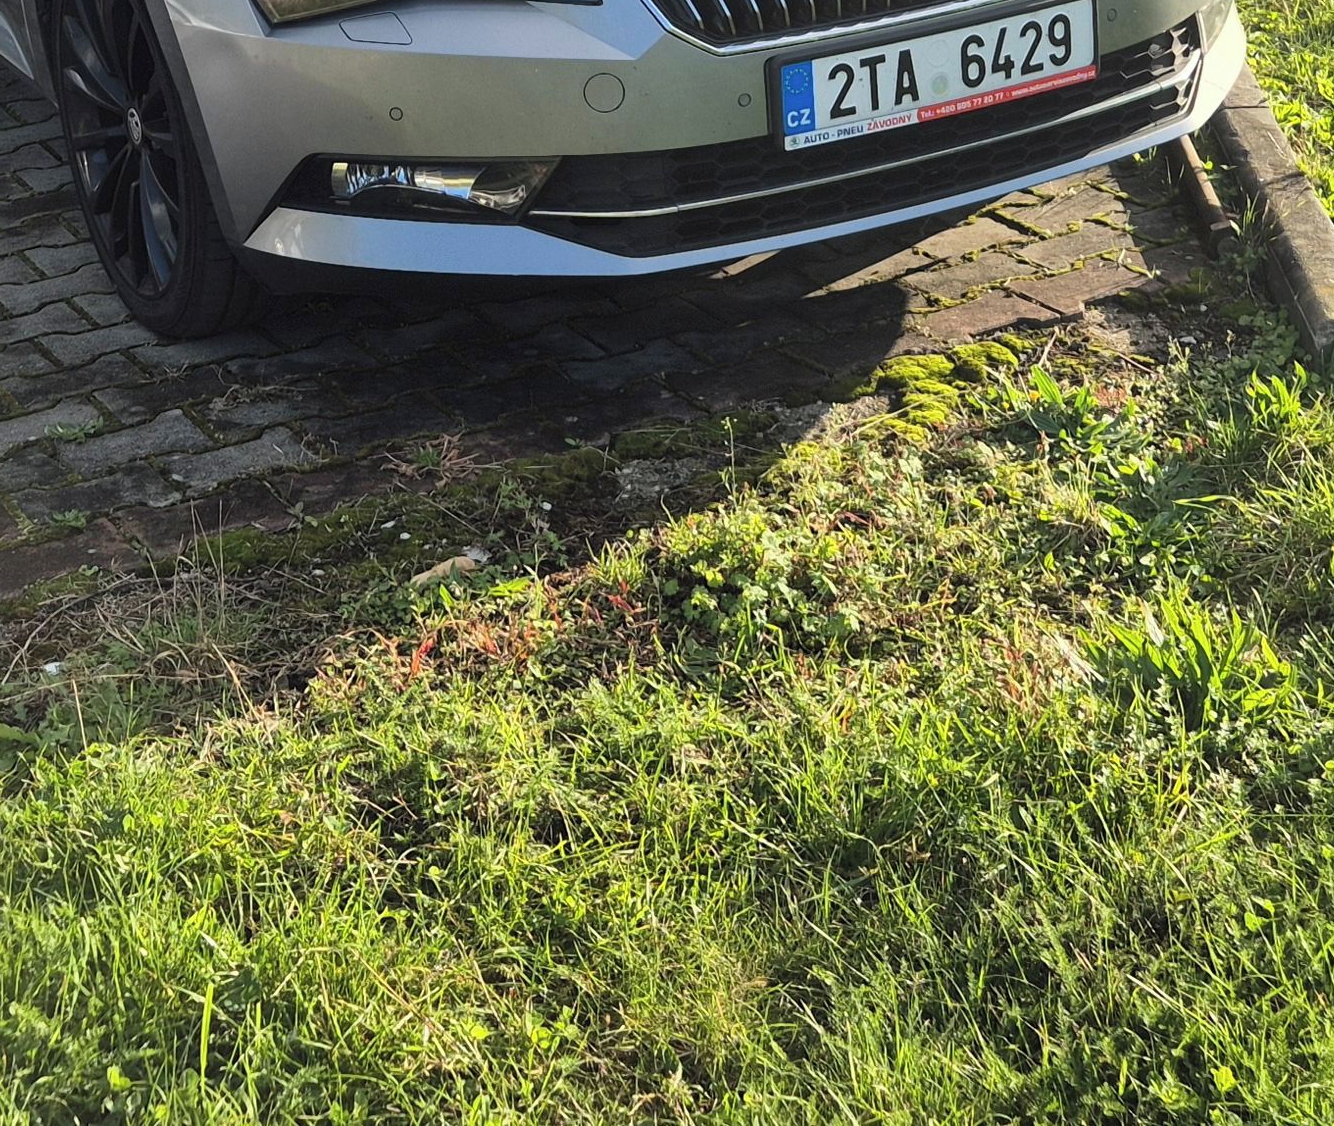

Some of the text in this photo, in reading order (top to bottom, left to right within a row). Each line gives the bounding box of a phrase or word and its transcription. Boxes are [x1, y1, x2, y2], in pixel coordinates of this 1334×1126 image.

[828, 13, 1072, 119] 2TA 6429
[787, 108, 812, 127] CZ
[803, 130, 830, 144] AUTO
[837, 126, 864, 138] PNEU
